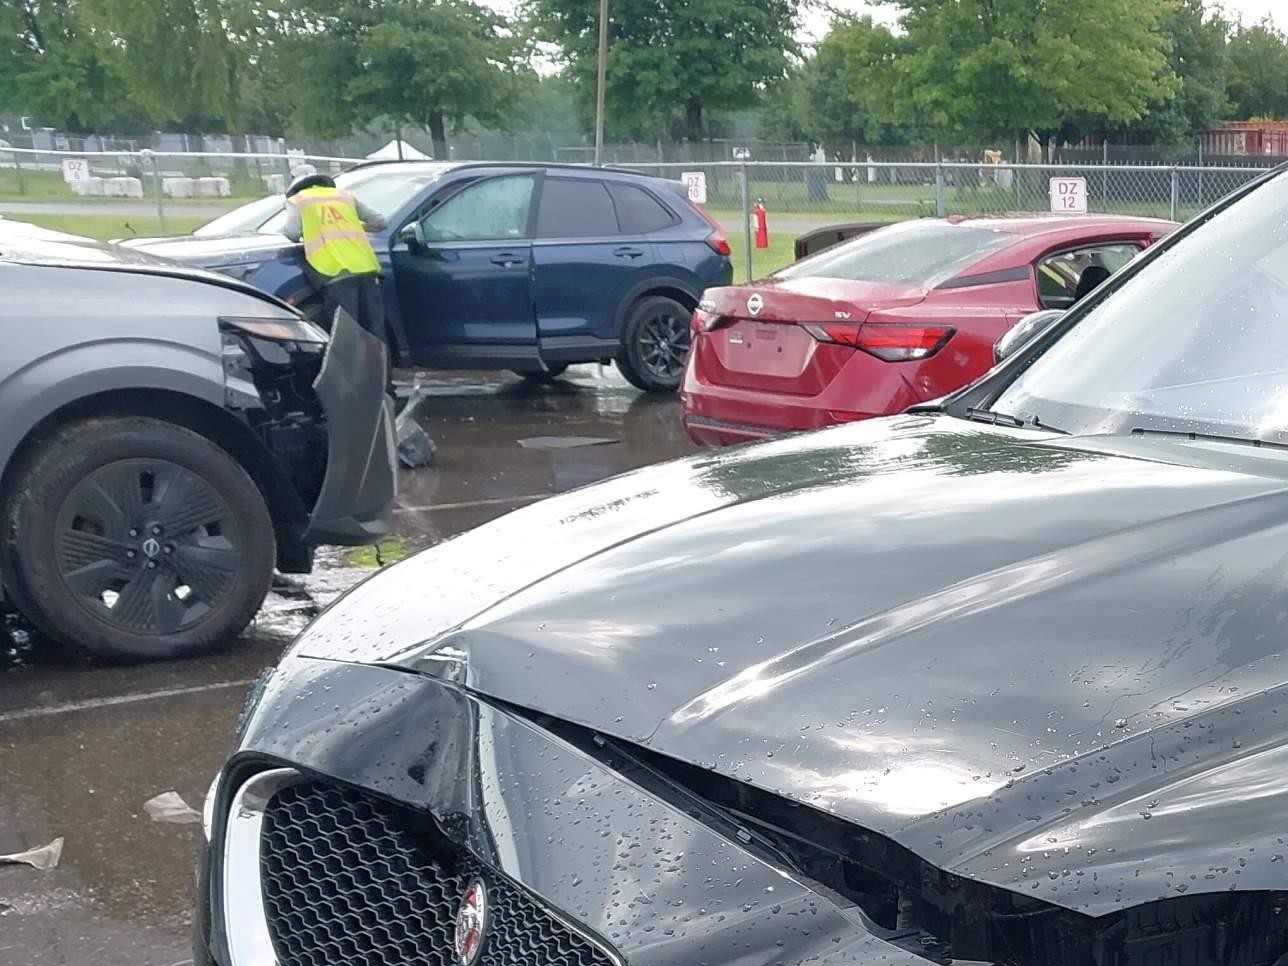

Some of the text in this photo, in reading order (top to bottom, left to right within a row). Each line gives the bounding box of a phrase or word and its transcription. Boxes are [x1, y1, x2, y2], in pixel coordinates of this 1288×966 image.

[687, 177, 700, 187] DZ
[1058, 182, 1078, 195] DZ
[1061, 196, 1076, 208] 12
